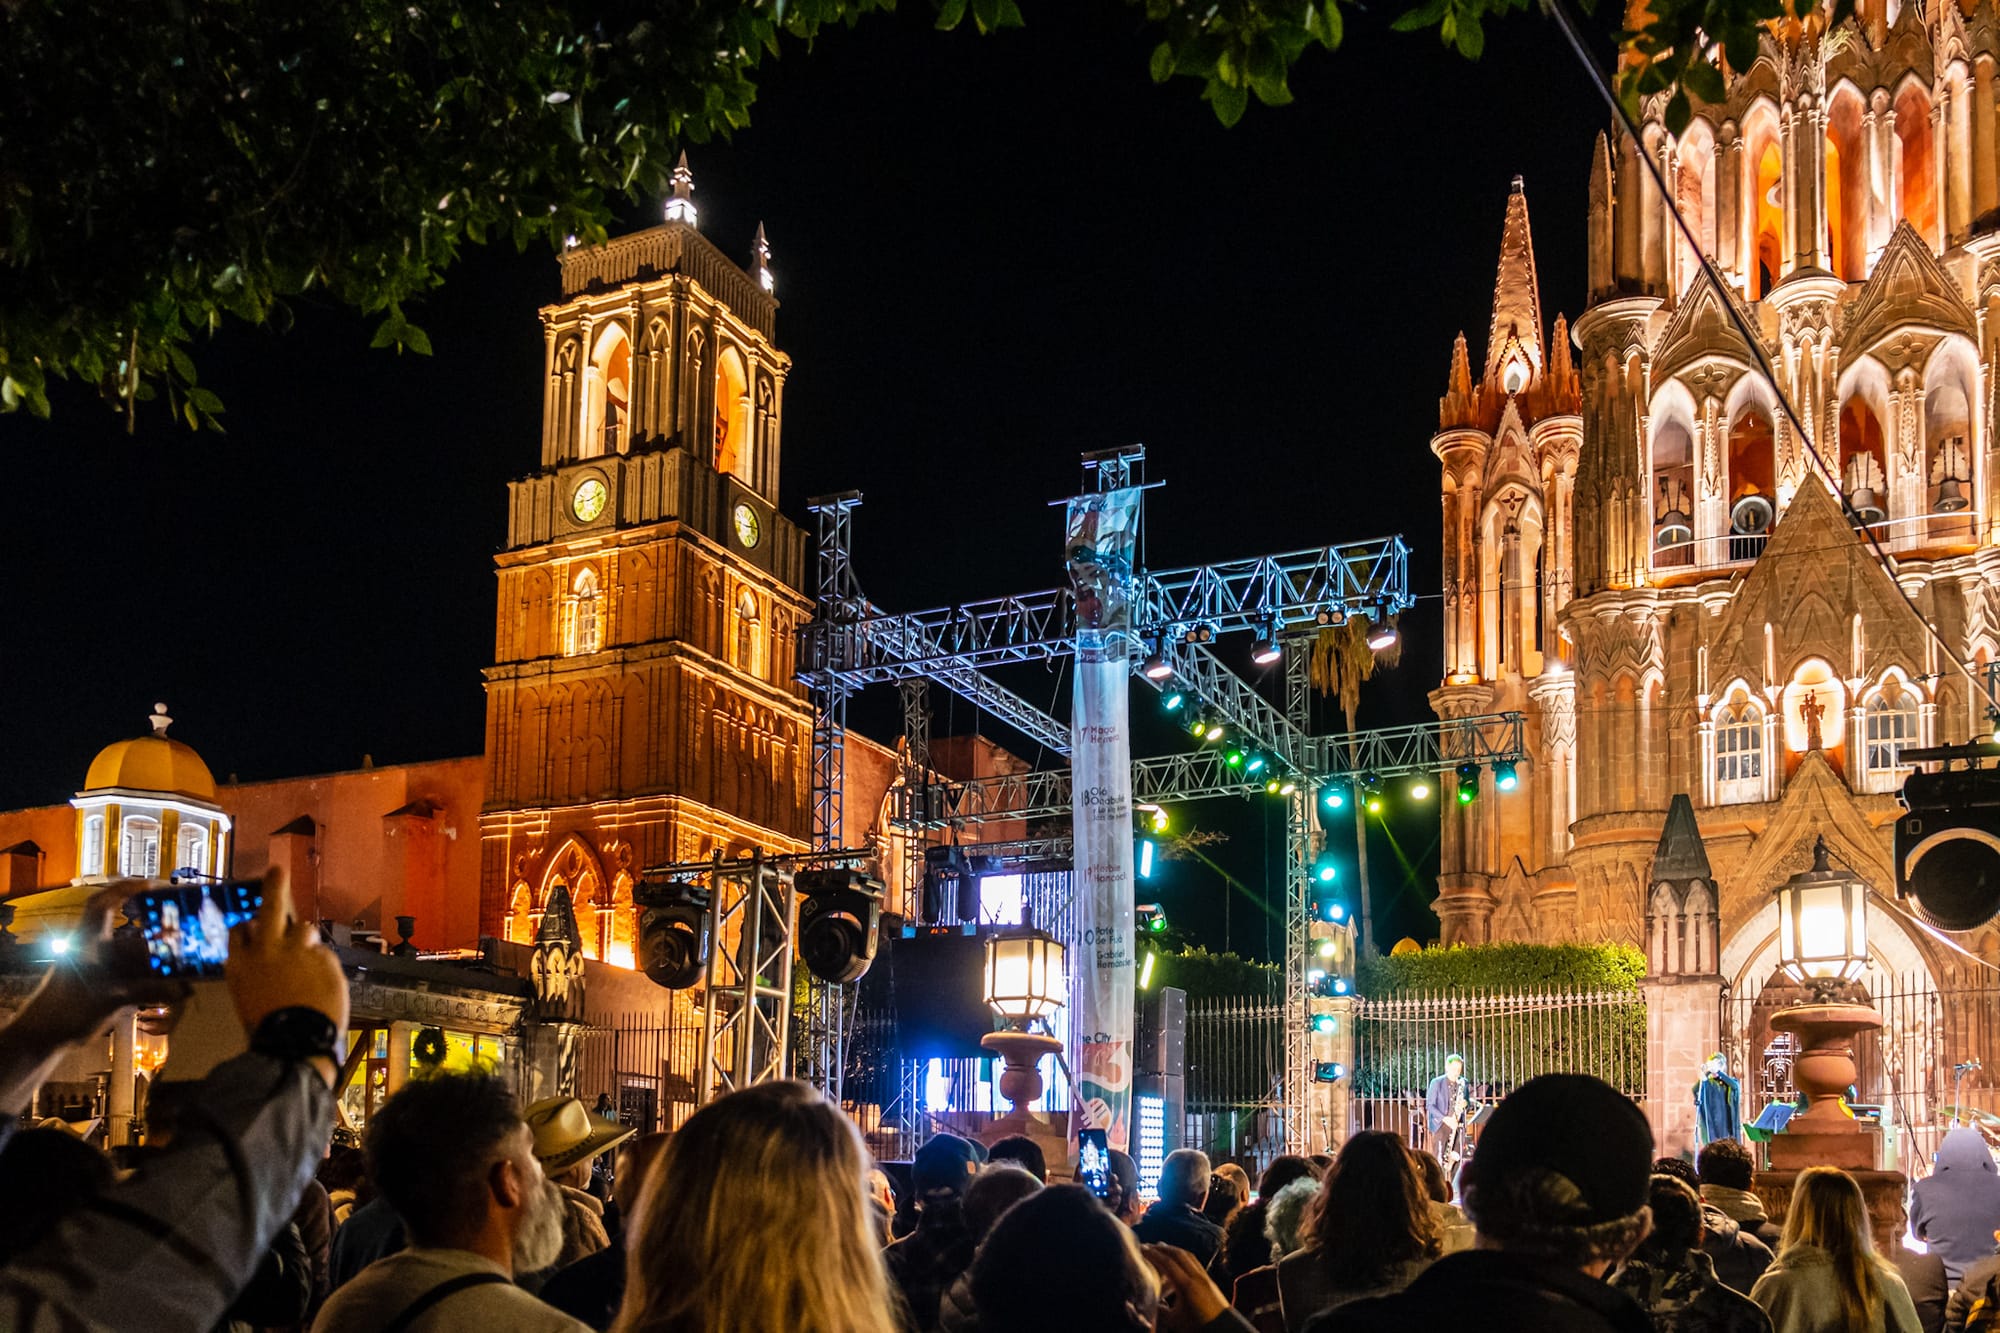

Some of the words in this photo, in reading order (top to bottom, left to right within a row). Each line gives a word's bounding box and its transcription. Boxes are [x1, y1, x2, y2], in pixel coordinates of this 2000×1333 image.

[1081, 789, 1090, 807] 18
[1906, 819, 1922, 835] 10
[1094, 1031, 1111, 1045] City
